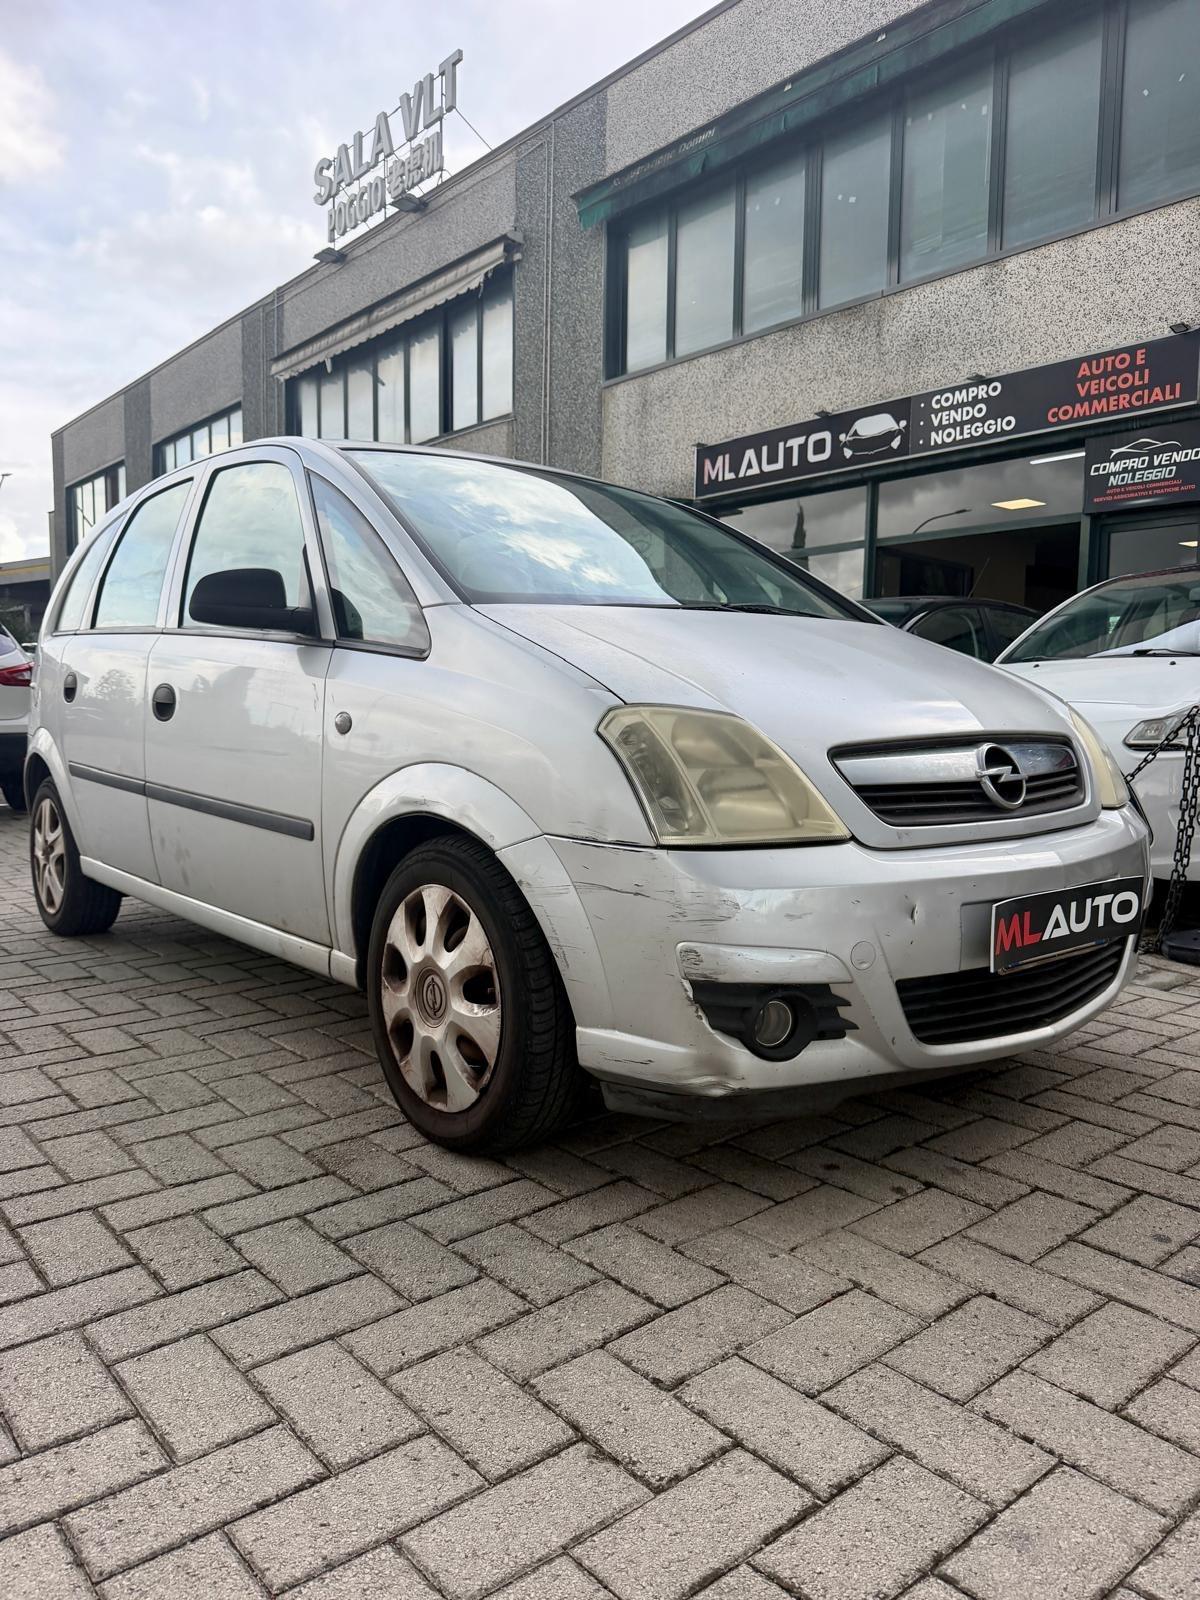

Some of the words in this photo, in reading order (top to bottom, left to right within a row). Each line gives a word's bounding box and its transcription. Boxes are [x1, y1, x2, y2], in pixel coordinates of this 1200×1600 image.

[313, 111, 394, 206] SALA
[399, 48, 463, 142] VLT
[327, 176, 385, 243] POGGIO
[1077, 353, 1130, 378] AUTO
[1136, 348, 1146, 365] E
[931, 381, 1001, 409] COMPRO
[1077, 368, 1149, 397] VEICOLI
[931, 403, 987, 427] VENDO
[1047, 383, 1181, 423] COMMERCIALI
[930, 415, 1016, 446] NOLEGGIO
[1090, 456, 1149, 476] COMPRO
[1153, 447, 1200, 466] VENDO
[1108, 466, 1176, 487] NOLEGGIO
